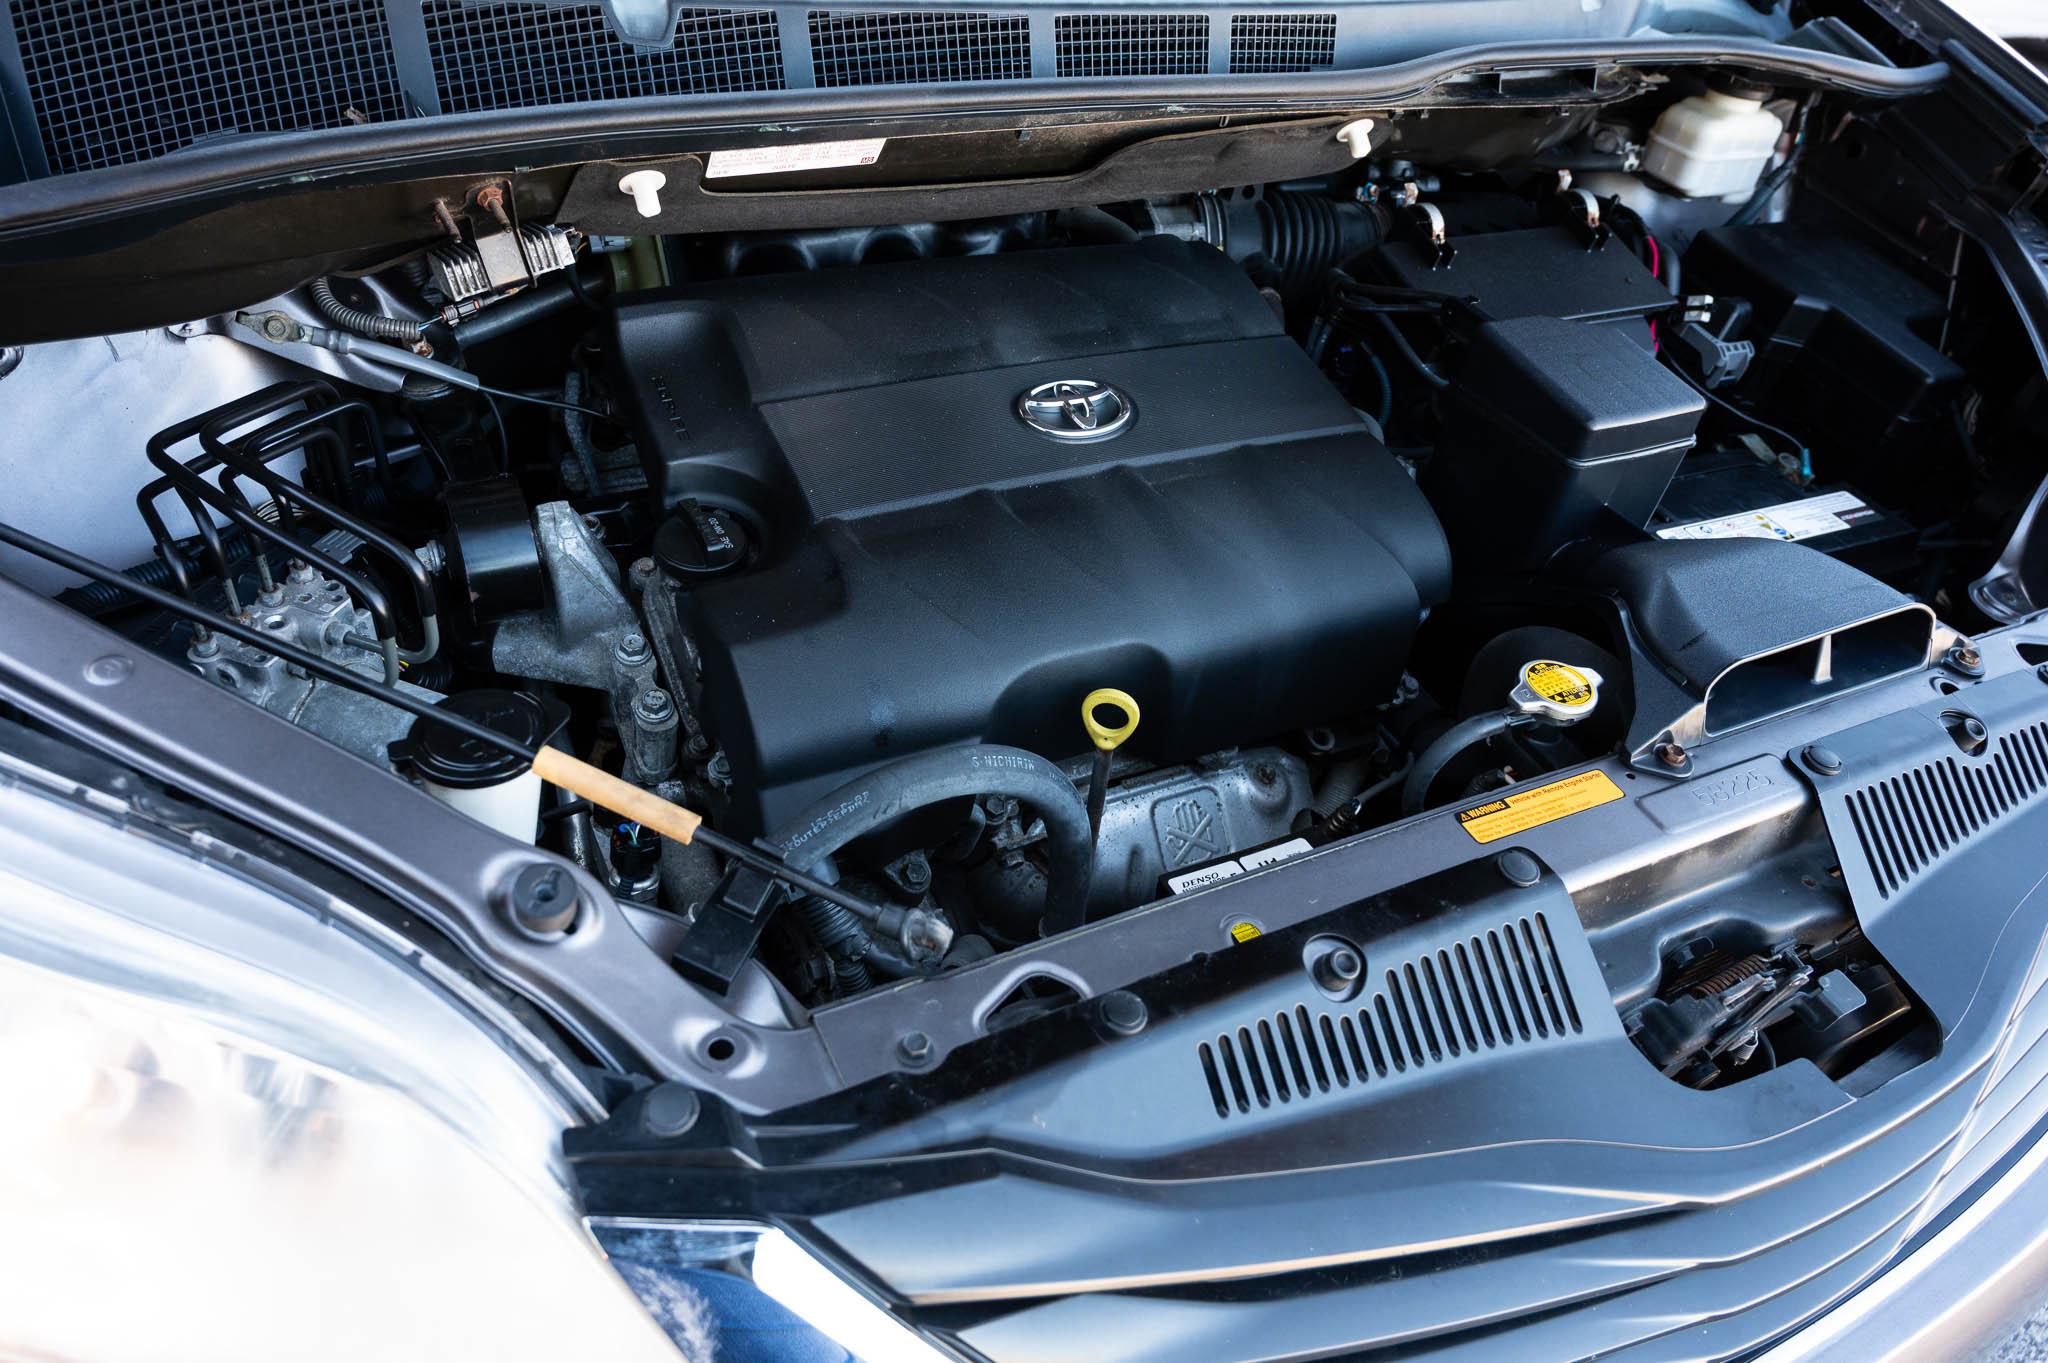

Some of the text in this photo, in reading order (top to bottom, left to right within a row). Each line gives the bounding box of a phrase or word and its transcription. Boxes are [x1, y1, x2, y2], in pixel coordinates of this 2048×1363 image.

[1468, 772, 1602, 818] WARNING Vehicle with Remote Engine Starter
[1182, 872, 1219, 889] DENSO
